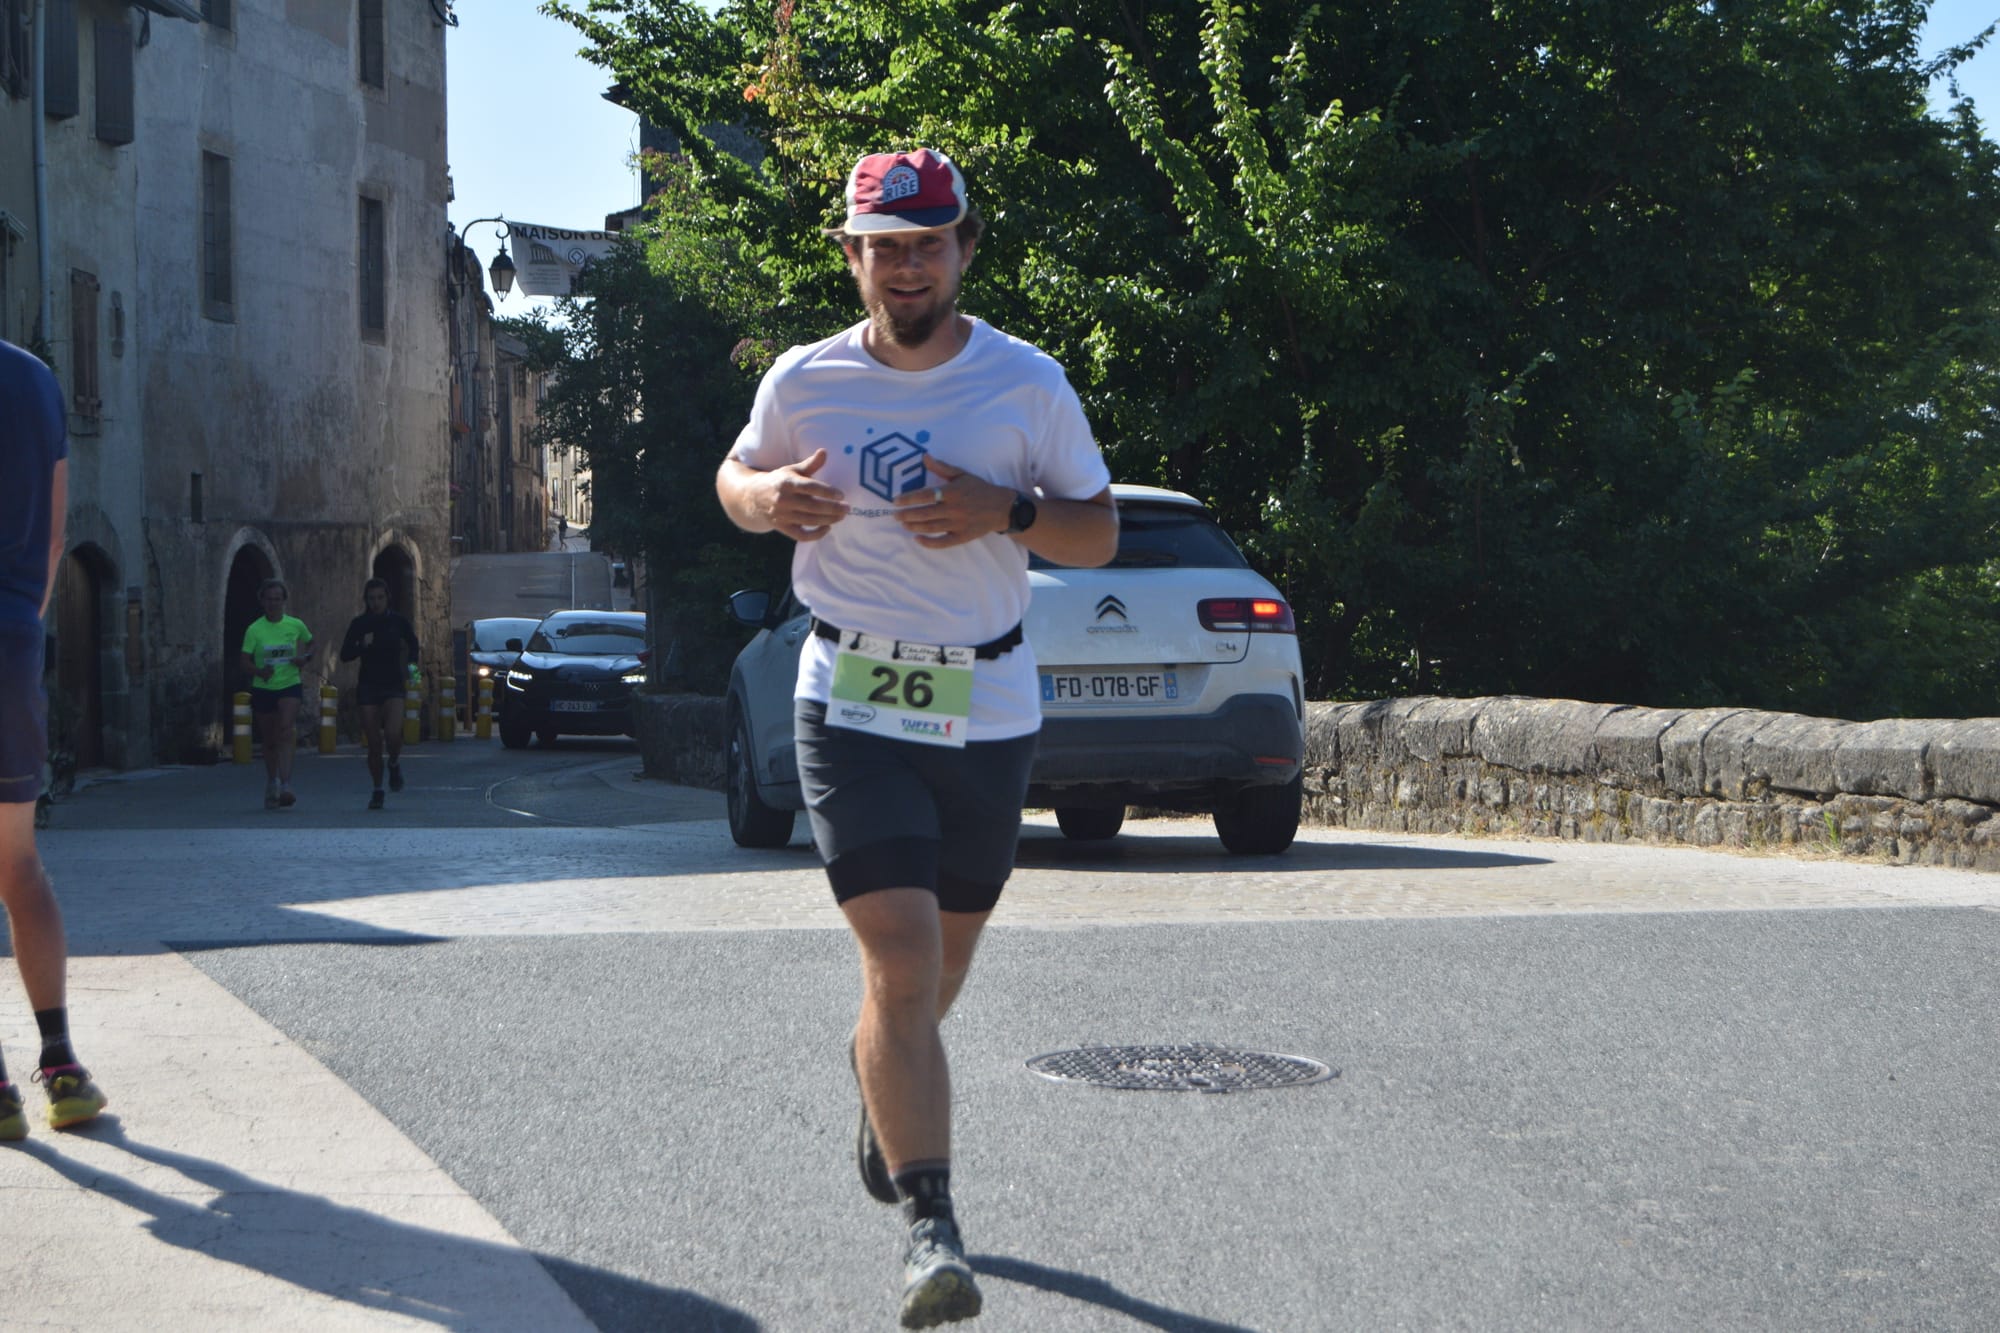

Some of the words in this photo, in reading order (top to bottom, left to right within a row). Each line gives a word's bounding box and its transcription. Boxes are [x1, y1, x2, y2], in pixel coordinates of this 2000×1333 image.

[886, 179, 917, 200] RISE
[514, 226, 585, 241] MAISON
[868, 666, 934, 708] 26
[1055, 676, 1160, 698] FD-078-GF
[1167, 686, 1177, 697] 13
